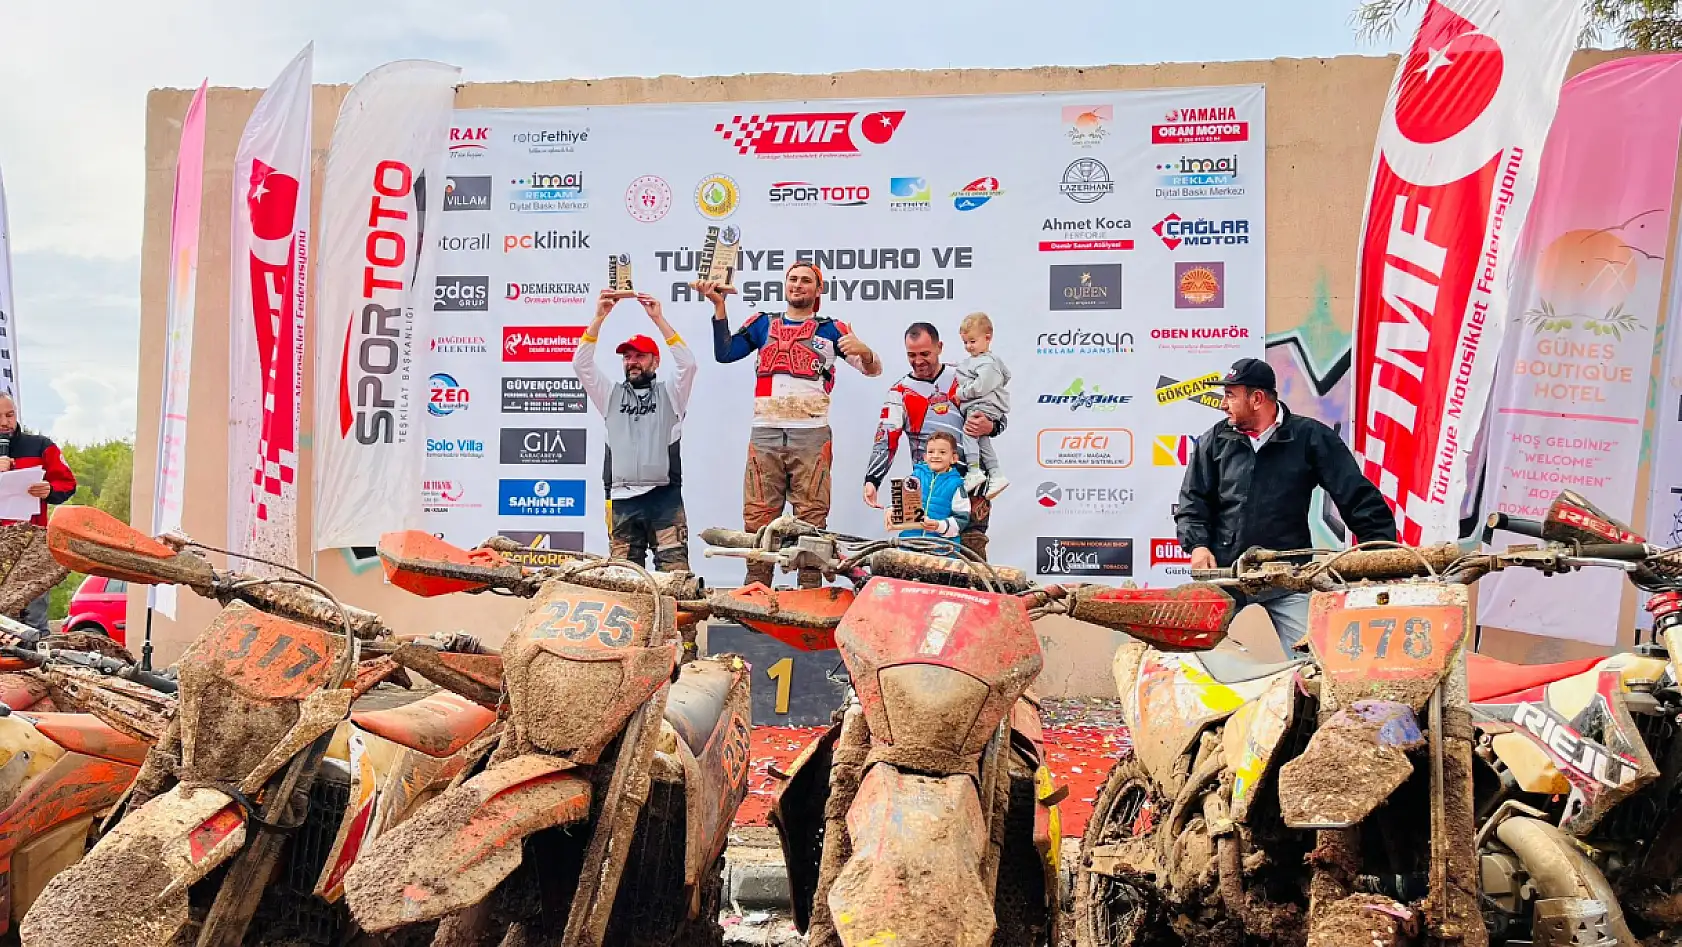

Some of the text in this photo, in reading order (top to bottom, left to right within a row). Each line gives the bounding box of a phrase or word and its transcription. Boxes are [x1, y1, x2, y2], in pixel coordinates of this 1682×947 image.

[1180, 107, 1236, 121] YAMAHA
[513, 130, 588, 144] rotaFethiye
[771, 119, 847, 145] TMF
[1159, 125, 1241, 137] ORAN MOTOR
[1180, 154, 1237, 178] imaj
[531, 171, 582, 193] imaj
[1060, 183, 1114, 192] LAZERHANE
[1173, 176, 1227, 185] REKLAM
[526, 191, 573, 200] REKLAM
[1042, 217, 1132, 231] Ahmet Koca
[1166, 217, 1249, 239] ÇAĞLAR
[503, 230, 590, 253] pcklinik
[1184, 235, 1249, 246] MOTOR
[655, 246, 784, 272] TÜİYE
[795, 247, 921, 270] ENDURO
[932, 246, 973, 269] VE
[521, 282, 589, 295] DEMİRKIRAN
[742, 276, 954, 307] ŞAİYONASI
[1063, 286, 1108, 300] QUEEN
[458, 299, 485, 307] GRUP
[1367, 193, 1448, 434] TMF
[1150, 325, 1250, 339] OBEN KUAFÖR
[1430, 146, 1525, 506] Türkiye Motosiklet Federasyonu
[1537, 336, 1615, 362] GÜNEŞ
[1514, 359, 1633, 383] BOUTIQUE
[1534, 383, 1607, 403] HOTEL
[426, 438, 483, 451] Solo Villa
[913, 507, 925, 523] 2
[530, 599, 640, 649] 255
[917, 600, 965, 657] 1
[1335, 616, 1434, 661] 478
[225, 623, 322, 680] 317
[766, 657, 794, 714] 1
[1512, 700, 1637, 789] RIEJU
